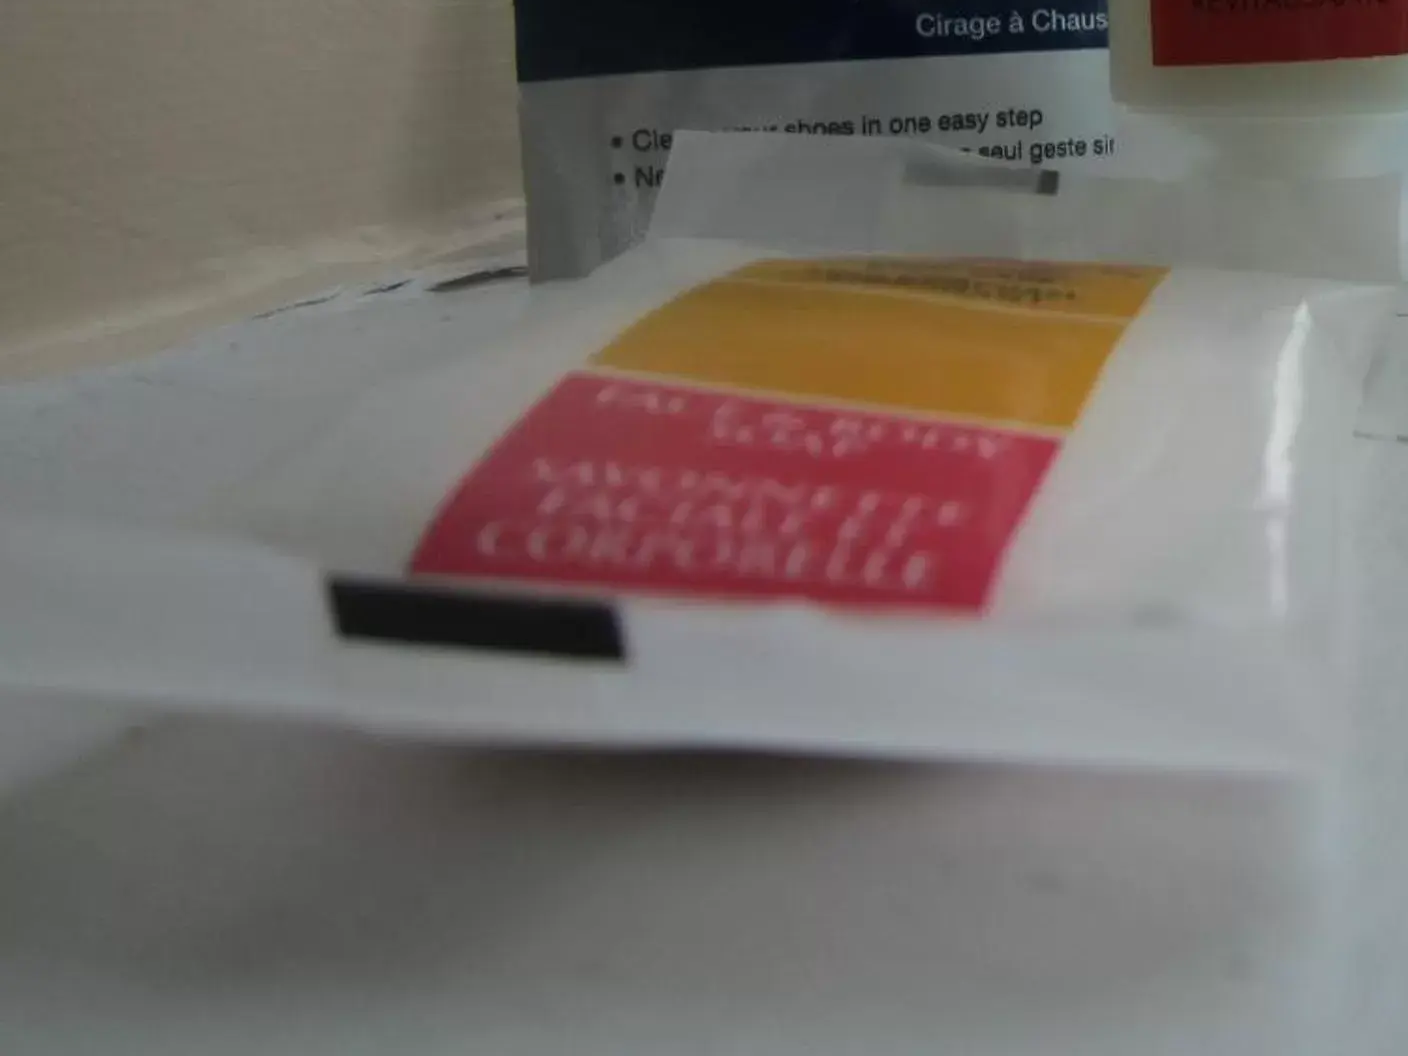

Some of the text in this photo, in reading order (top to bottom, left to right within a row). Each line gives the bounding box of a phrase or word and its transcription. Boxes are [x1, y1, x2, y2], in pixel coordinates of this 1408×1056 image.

[916, 12, 1000, 41] Cirage
[1009, 11, 1025, 32] à
[862, 115, 882, 135] in
[890, 116, 932, 134] one
[938, 112, 989, 134] easy
[996, 107, 1043, 130] step
[1030, 138, 1087, 164] geste
